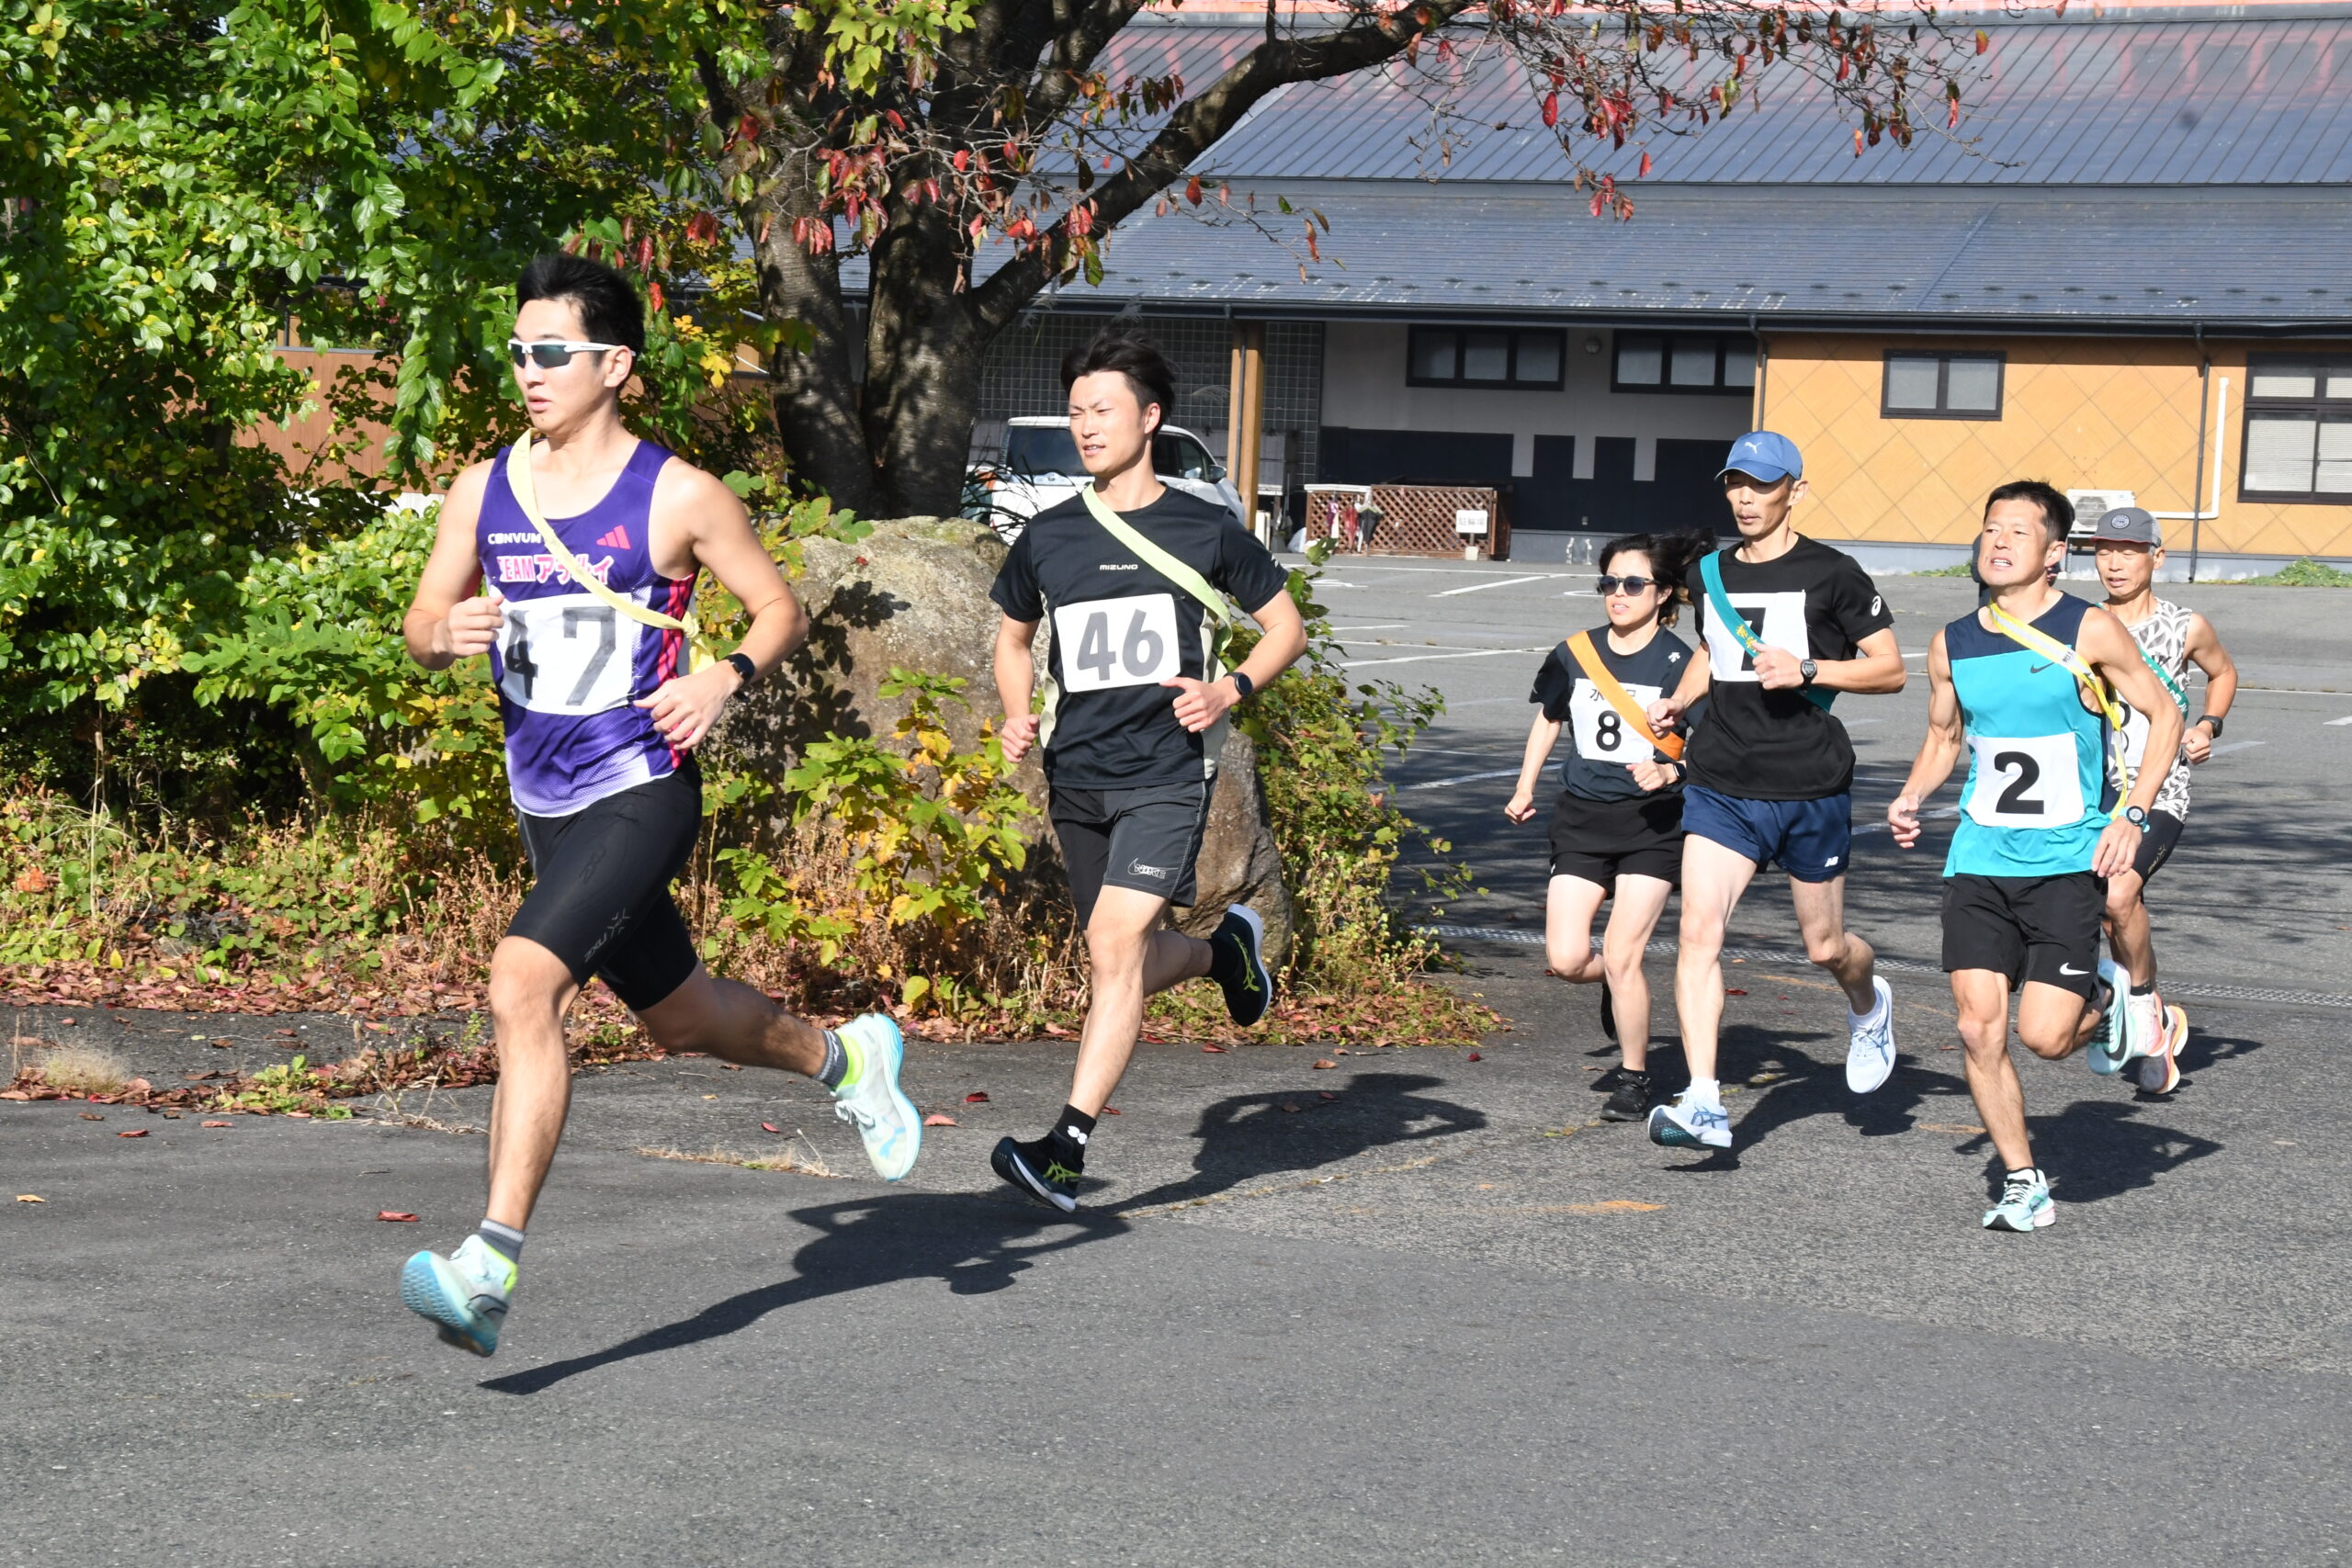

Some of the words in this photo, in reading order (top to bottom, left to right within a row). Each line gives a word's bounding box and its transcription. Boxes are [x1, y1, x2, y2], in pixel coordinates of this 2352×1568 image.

[488, 533, 542, 545] CONVUM
[504, 606, 616, 706] 47
[1077, 608, 1164, 682] 46
[1733, 607, 1767, 671] 7
[1596, 710, 1622, 751] 8
[1994, 750, 2045, 815] 2
